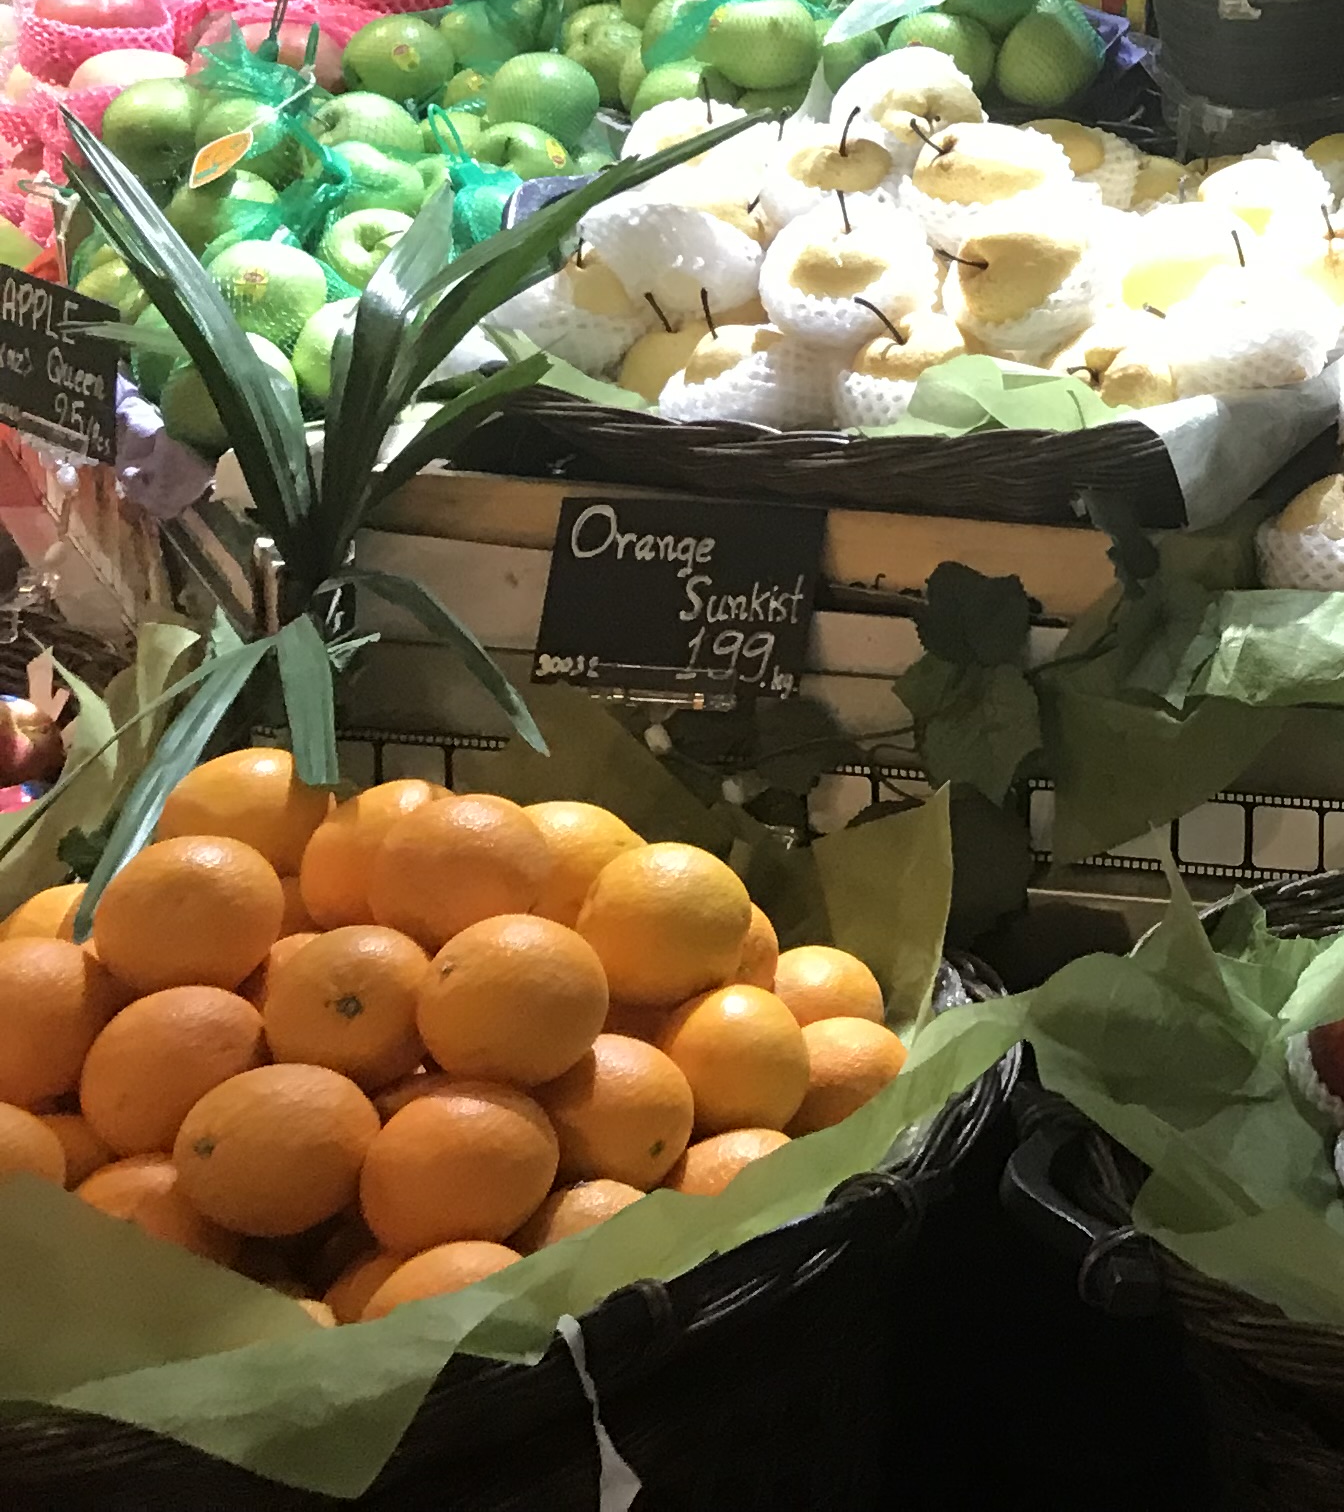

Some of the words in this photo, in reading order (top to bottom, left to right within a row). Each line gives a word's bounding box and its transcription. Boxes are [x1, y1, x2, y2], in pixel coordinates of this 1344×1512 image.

[2, 277, 80, 345] APPLE
[571, 504, 716, 578] Orange
[679, 574, 805, 625] Sunkist
[676, 626, 775, 683] 199
